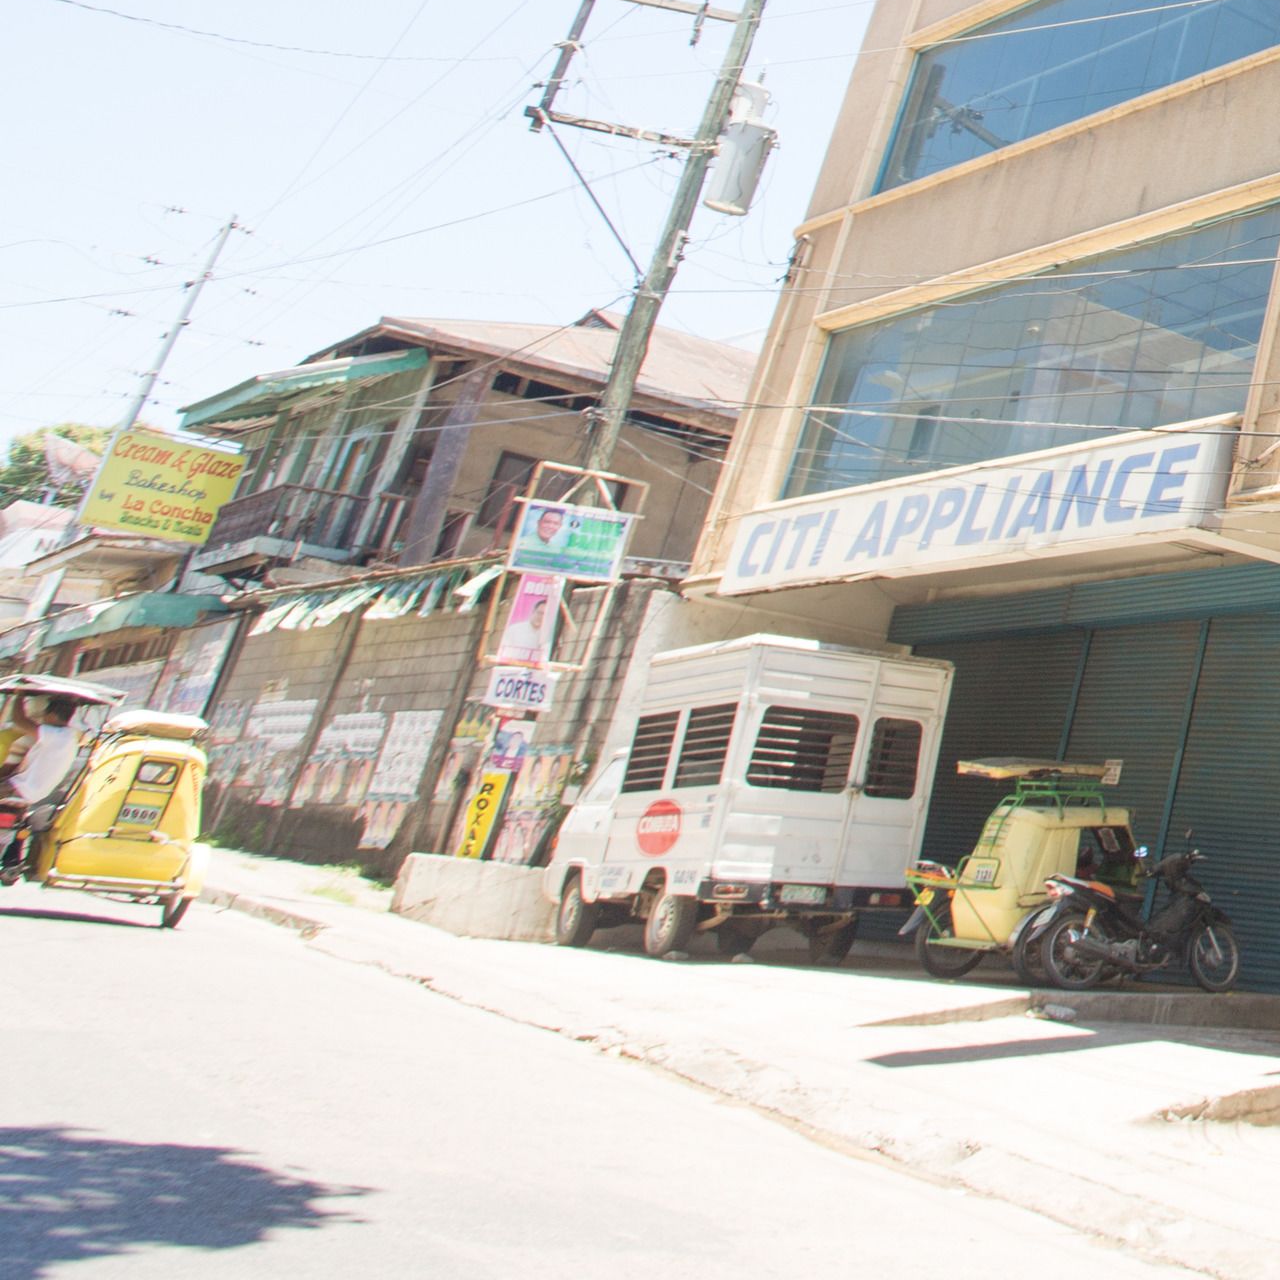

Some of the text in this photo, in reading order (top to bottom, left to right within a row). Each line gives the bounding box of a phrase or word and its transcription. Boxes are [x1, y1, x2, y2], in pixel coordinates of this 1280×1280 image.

[113, 435, 174, 466] Cream
[189, 453, 243, 479] Glaze
[124, 470, 208, 504] Bakeshop
[121, 494, 145, 512] La
[149, 499, 213, 524] Concha
[736, 509, 839, 578] CITI
[844, 443, 1201, 562] APPLIANCE
[495, 678, 548, 704] CORTES
[463, 783, 494, 856] ROXAS
